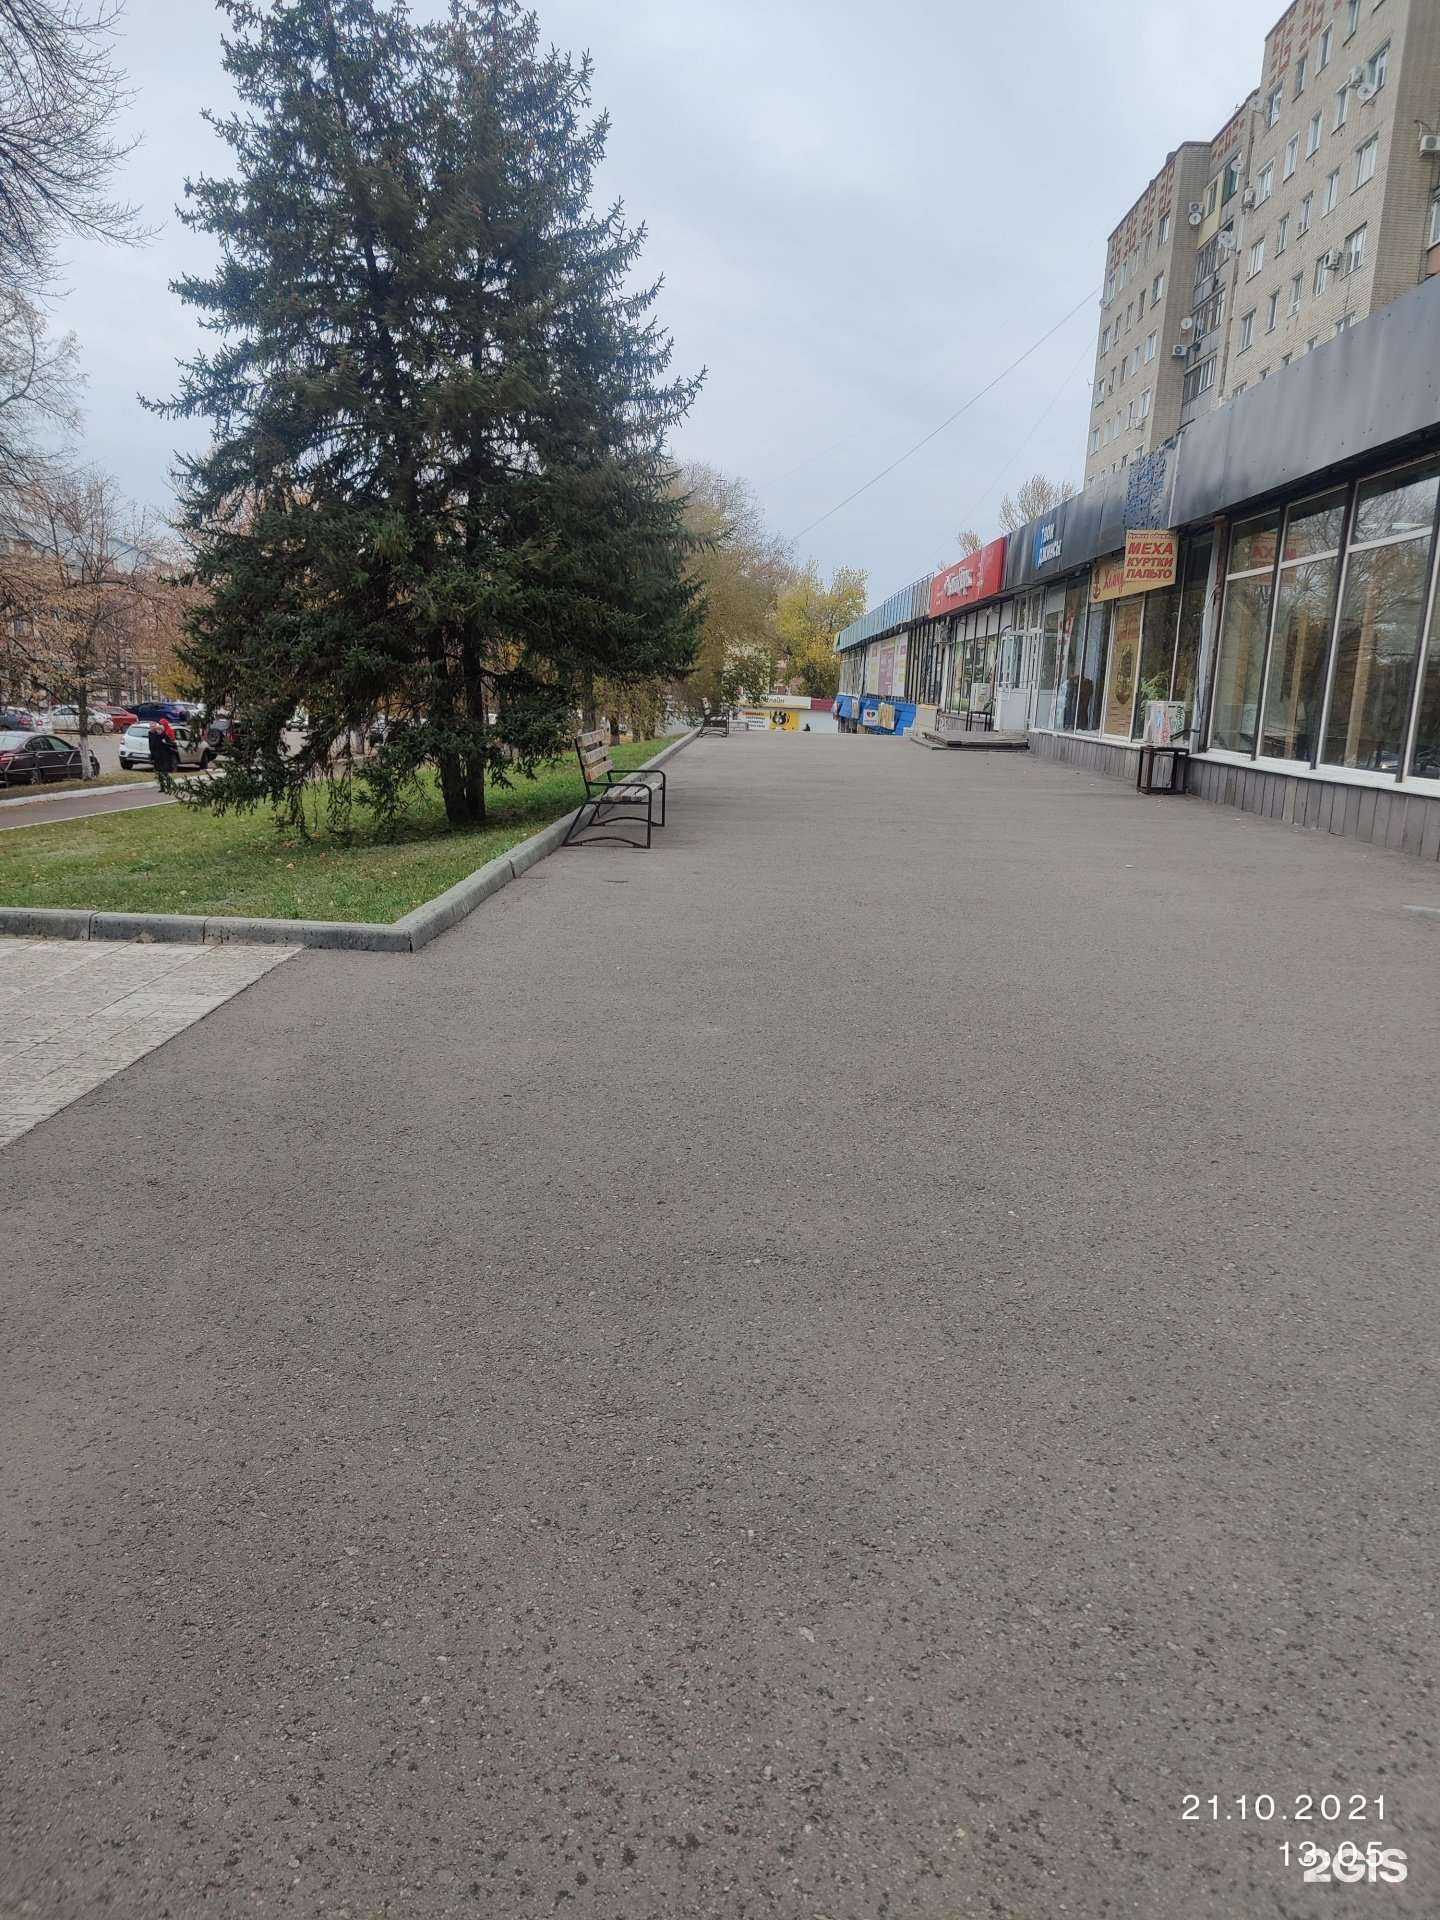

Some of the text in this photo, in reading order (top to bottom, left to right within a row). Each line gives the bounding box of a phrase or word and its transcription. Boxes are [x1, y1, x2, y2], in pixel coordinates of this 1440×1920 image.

[1128, 542, 1174, 555] МЕХА
[1126, 557, 1174, 568] КУРТКИ
[1126, 568, 1173, 579] ПАЛЬТО
